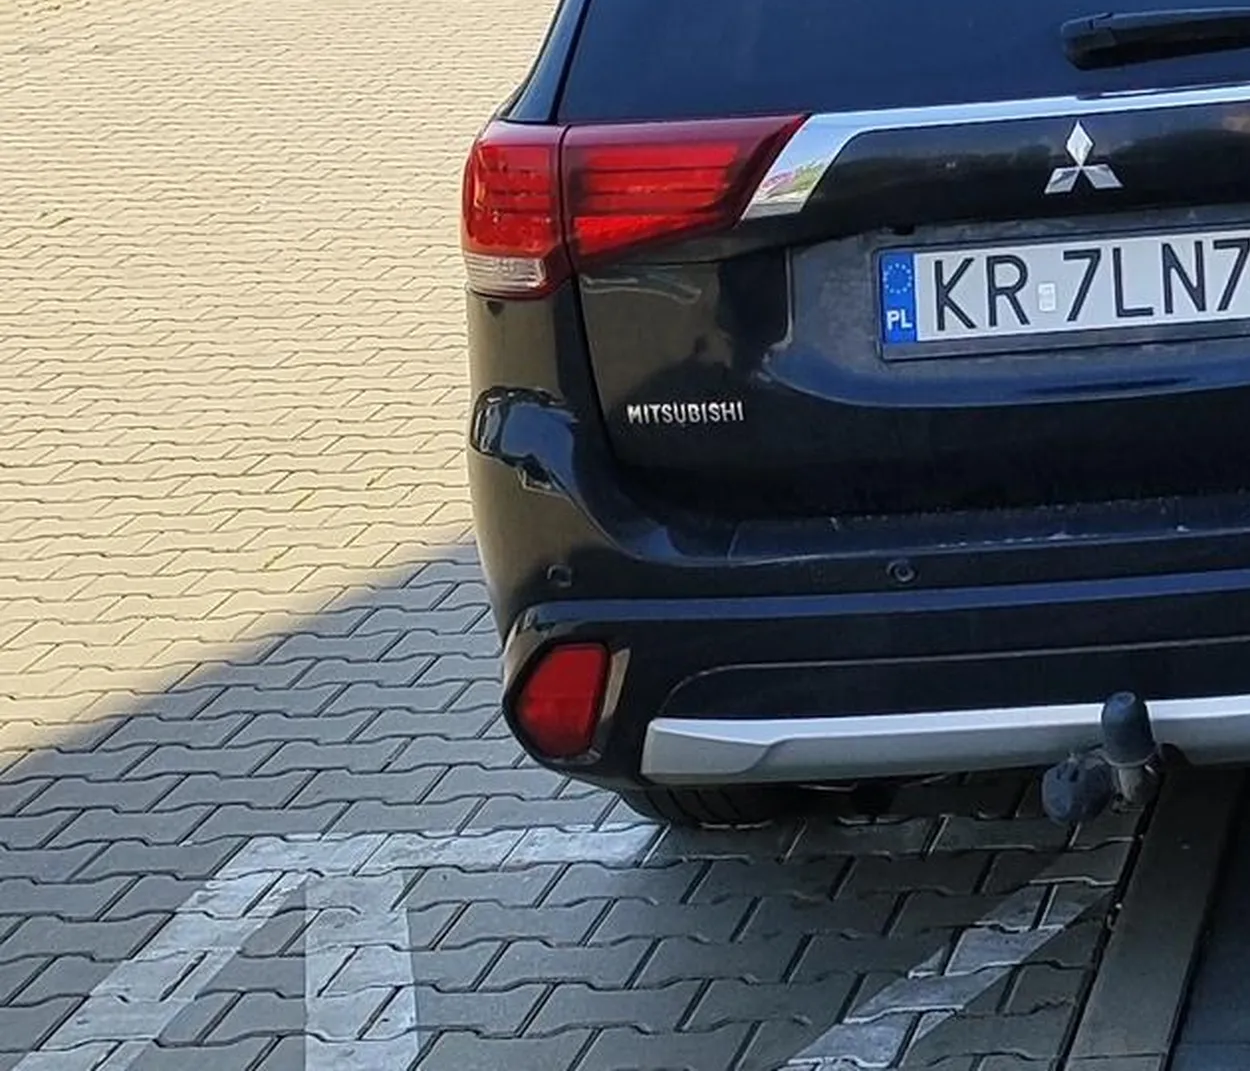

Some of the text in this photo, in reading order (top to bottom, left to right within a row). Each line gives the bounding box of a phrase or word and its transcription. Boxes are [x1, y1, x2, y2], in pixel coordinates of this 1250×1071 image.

[933, 254, 1030, 331] KR
[886, 309, 913, 330] PL
[627, 400, 744, 424] MITSUBISHI
